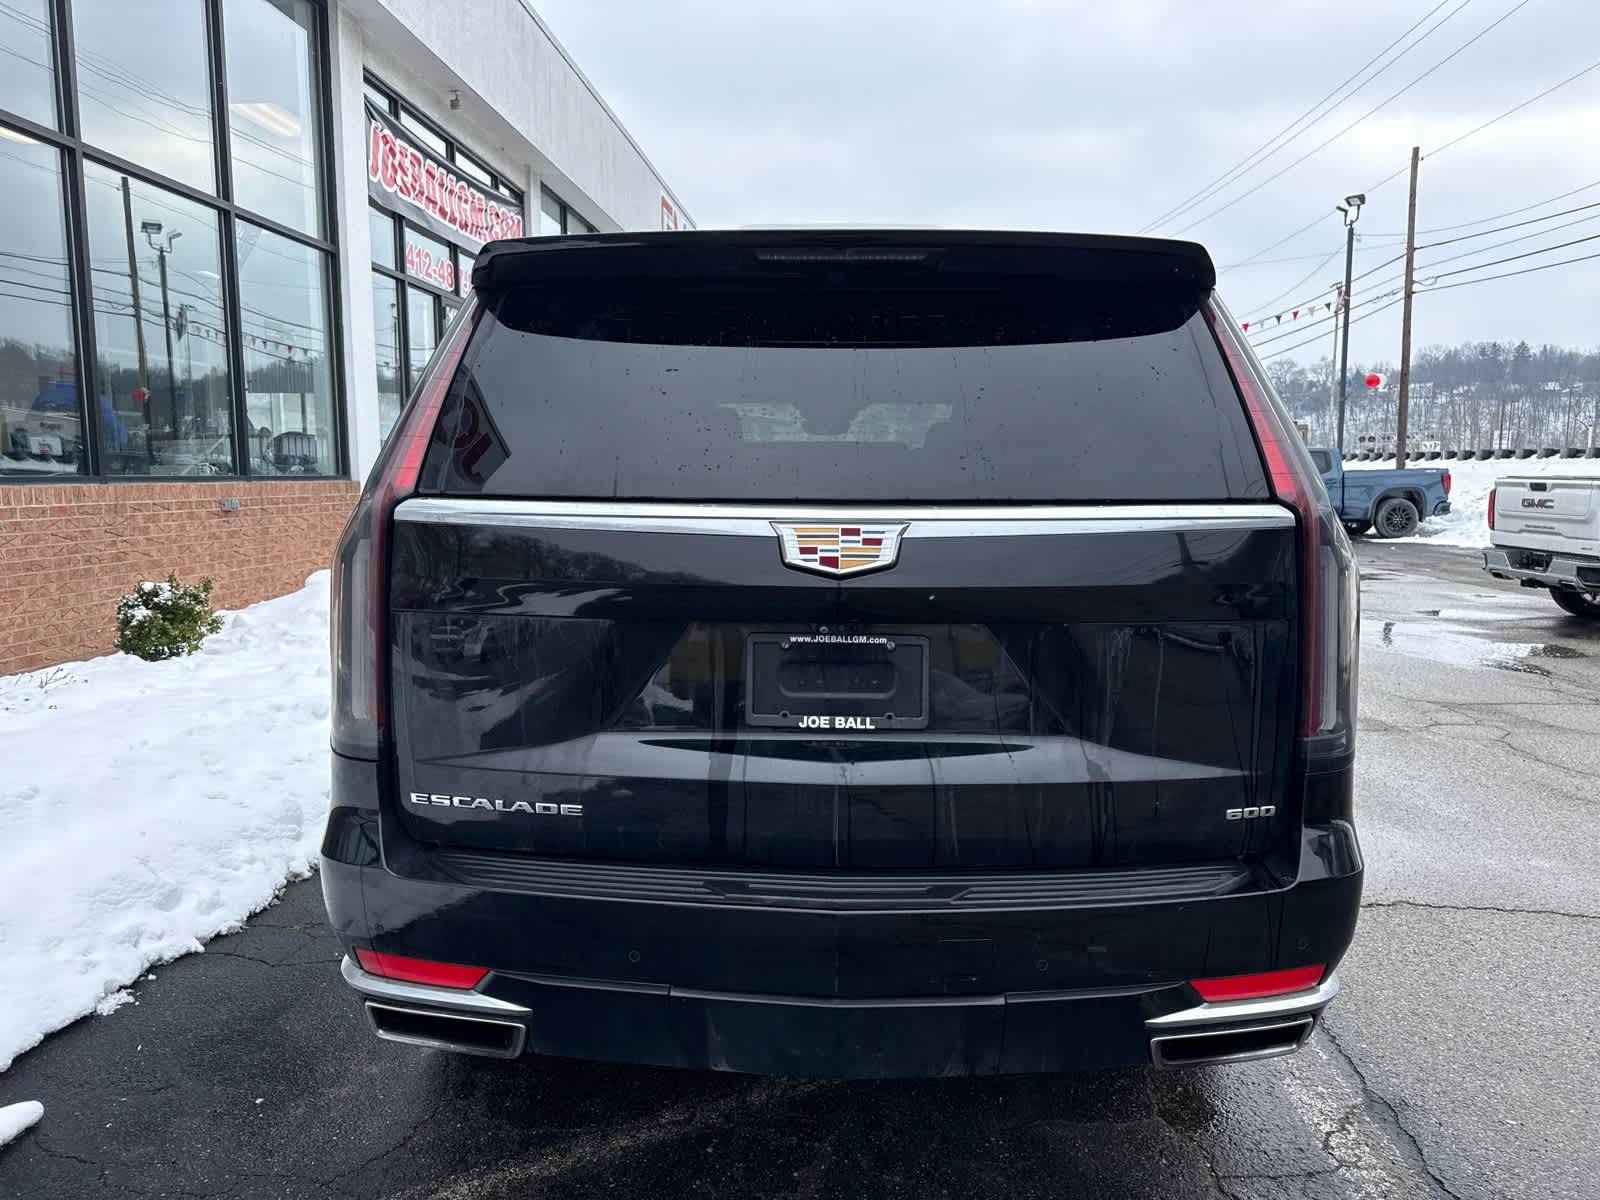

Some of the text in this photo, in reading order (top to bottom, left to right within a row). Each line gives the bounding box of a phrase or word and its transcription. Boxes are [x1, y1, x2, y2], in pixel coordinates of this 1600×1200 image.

[1521, 498, 1554, 509] GMC
[790, 635, 887, 645] www.JOEBALLGM.com
[799, 716, 875, 730] JOE BALL
[410, 792, 583, 816] ESCALADE
[1226, 805, 1276, 820] 600
